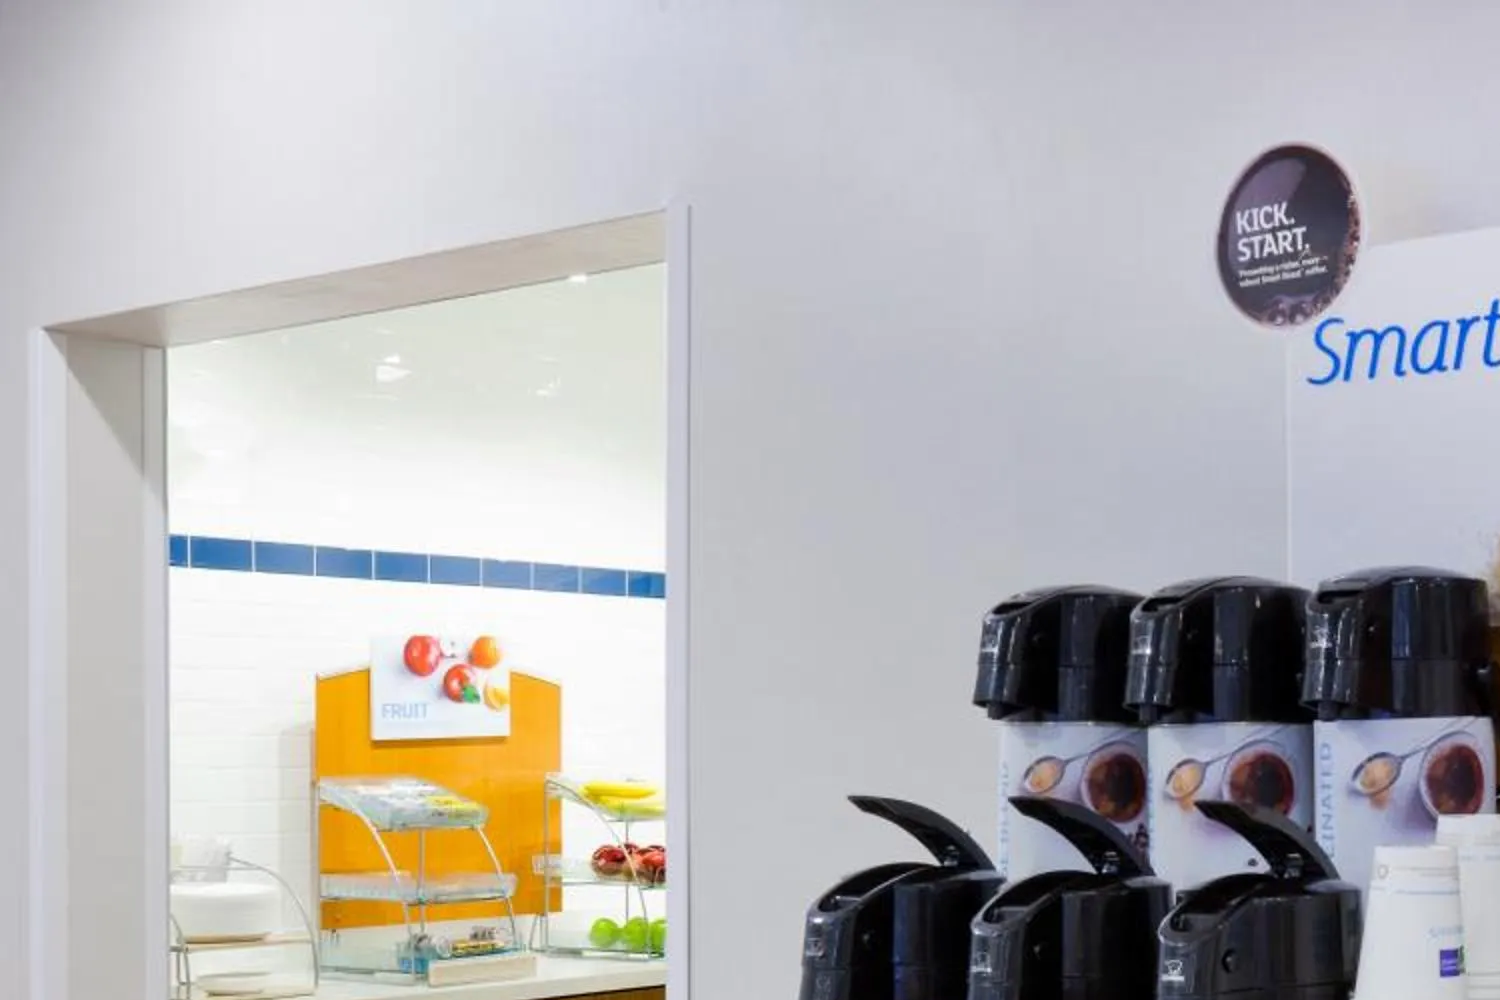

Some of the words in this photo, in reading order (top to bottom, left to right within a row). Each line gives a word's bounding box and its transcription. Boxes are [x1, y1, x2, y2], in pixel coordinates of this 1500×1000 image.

[1236, 202, 1296, 235] KICK.
[1238, 226, 1311, 262] START.
[381, 702, 430, 720] FRUIT
